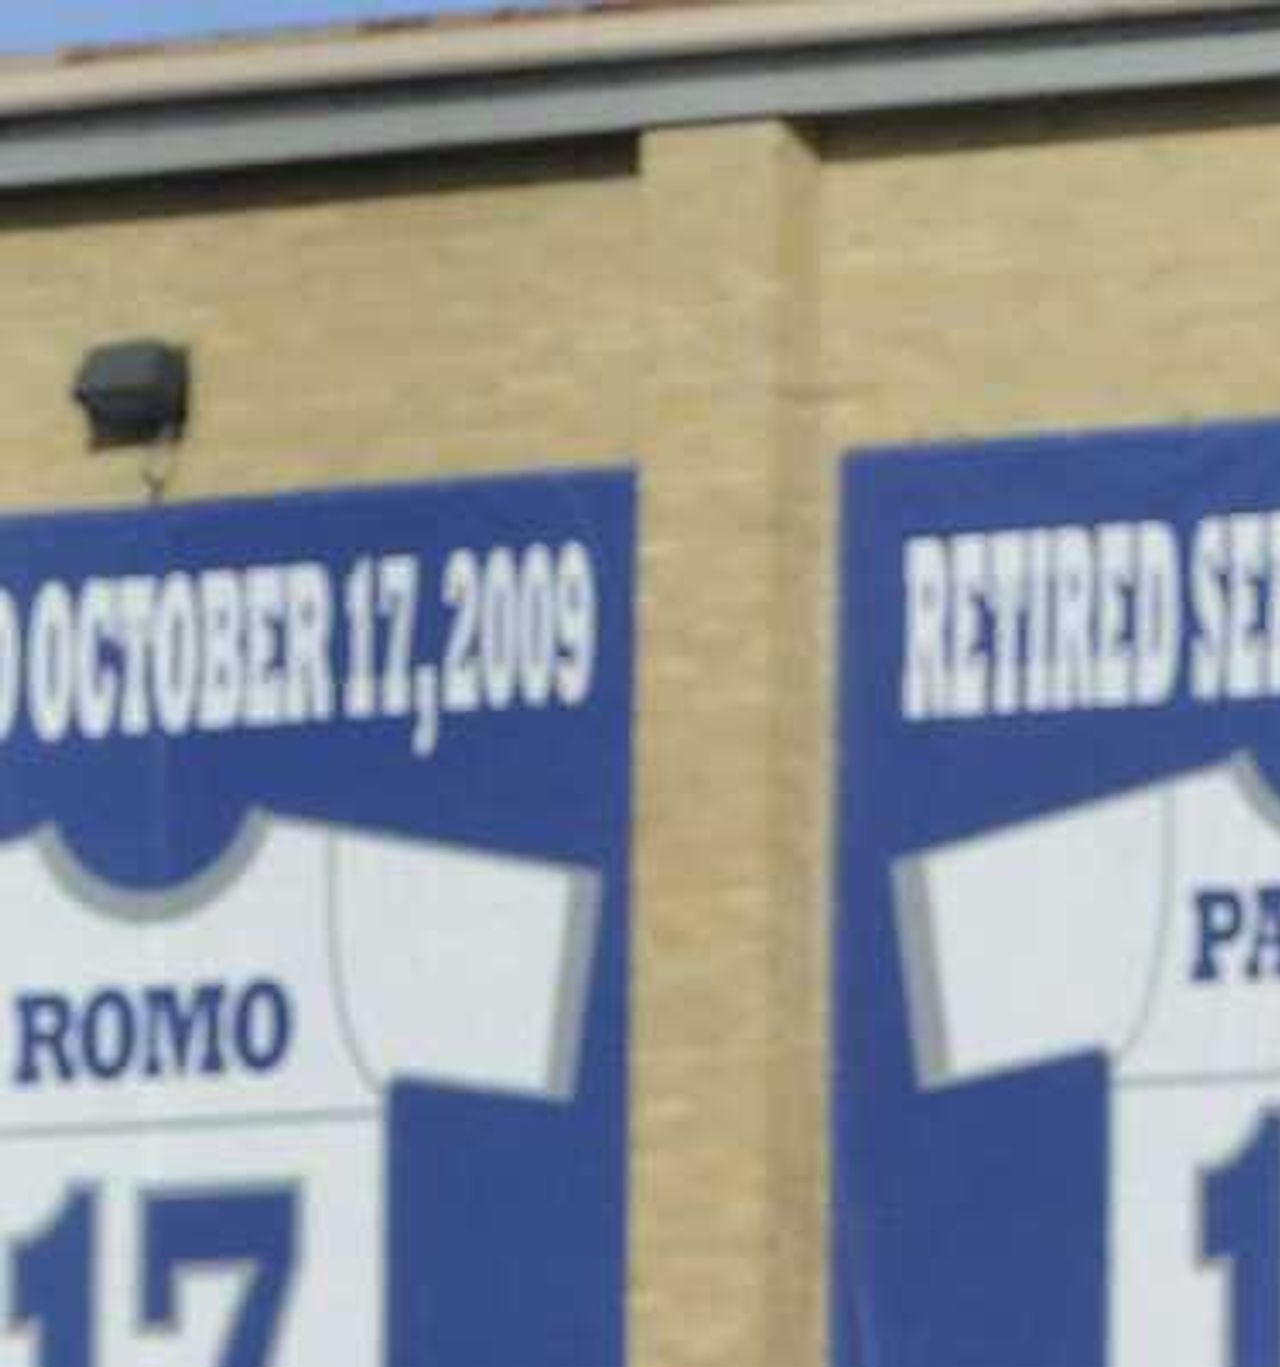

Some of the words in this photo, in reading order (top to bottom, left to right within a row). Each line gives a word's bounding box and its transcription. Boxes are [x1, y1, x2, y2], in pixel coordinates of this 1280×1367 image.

[27, 561, 333, 742] OCTOBER
[903, 521, 1180, 721] RETIRED
[12, 977, 291, 1083] ROMO
